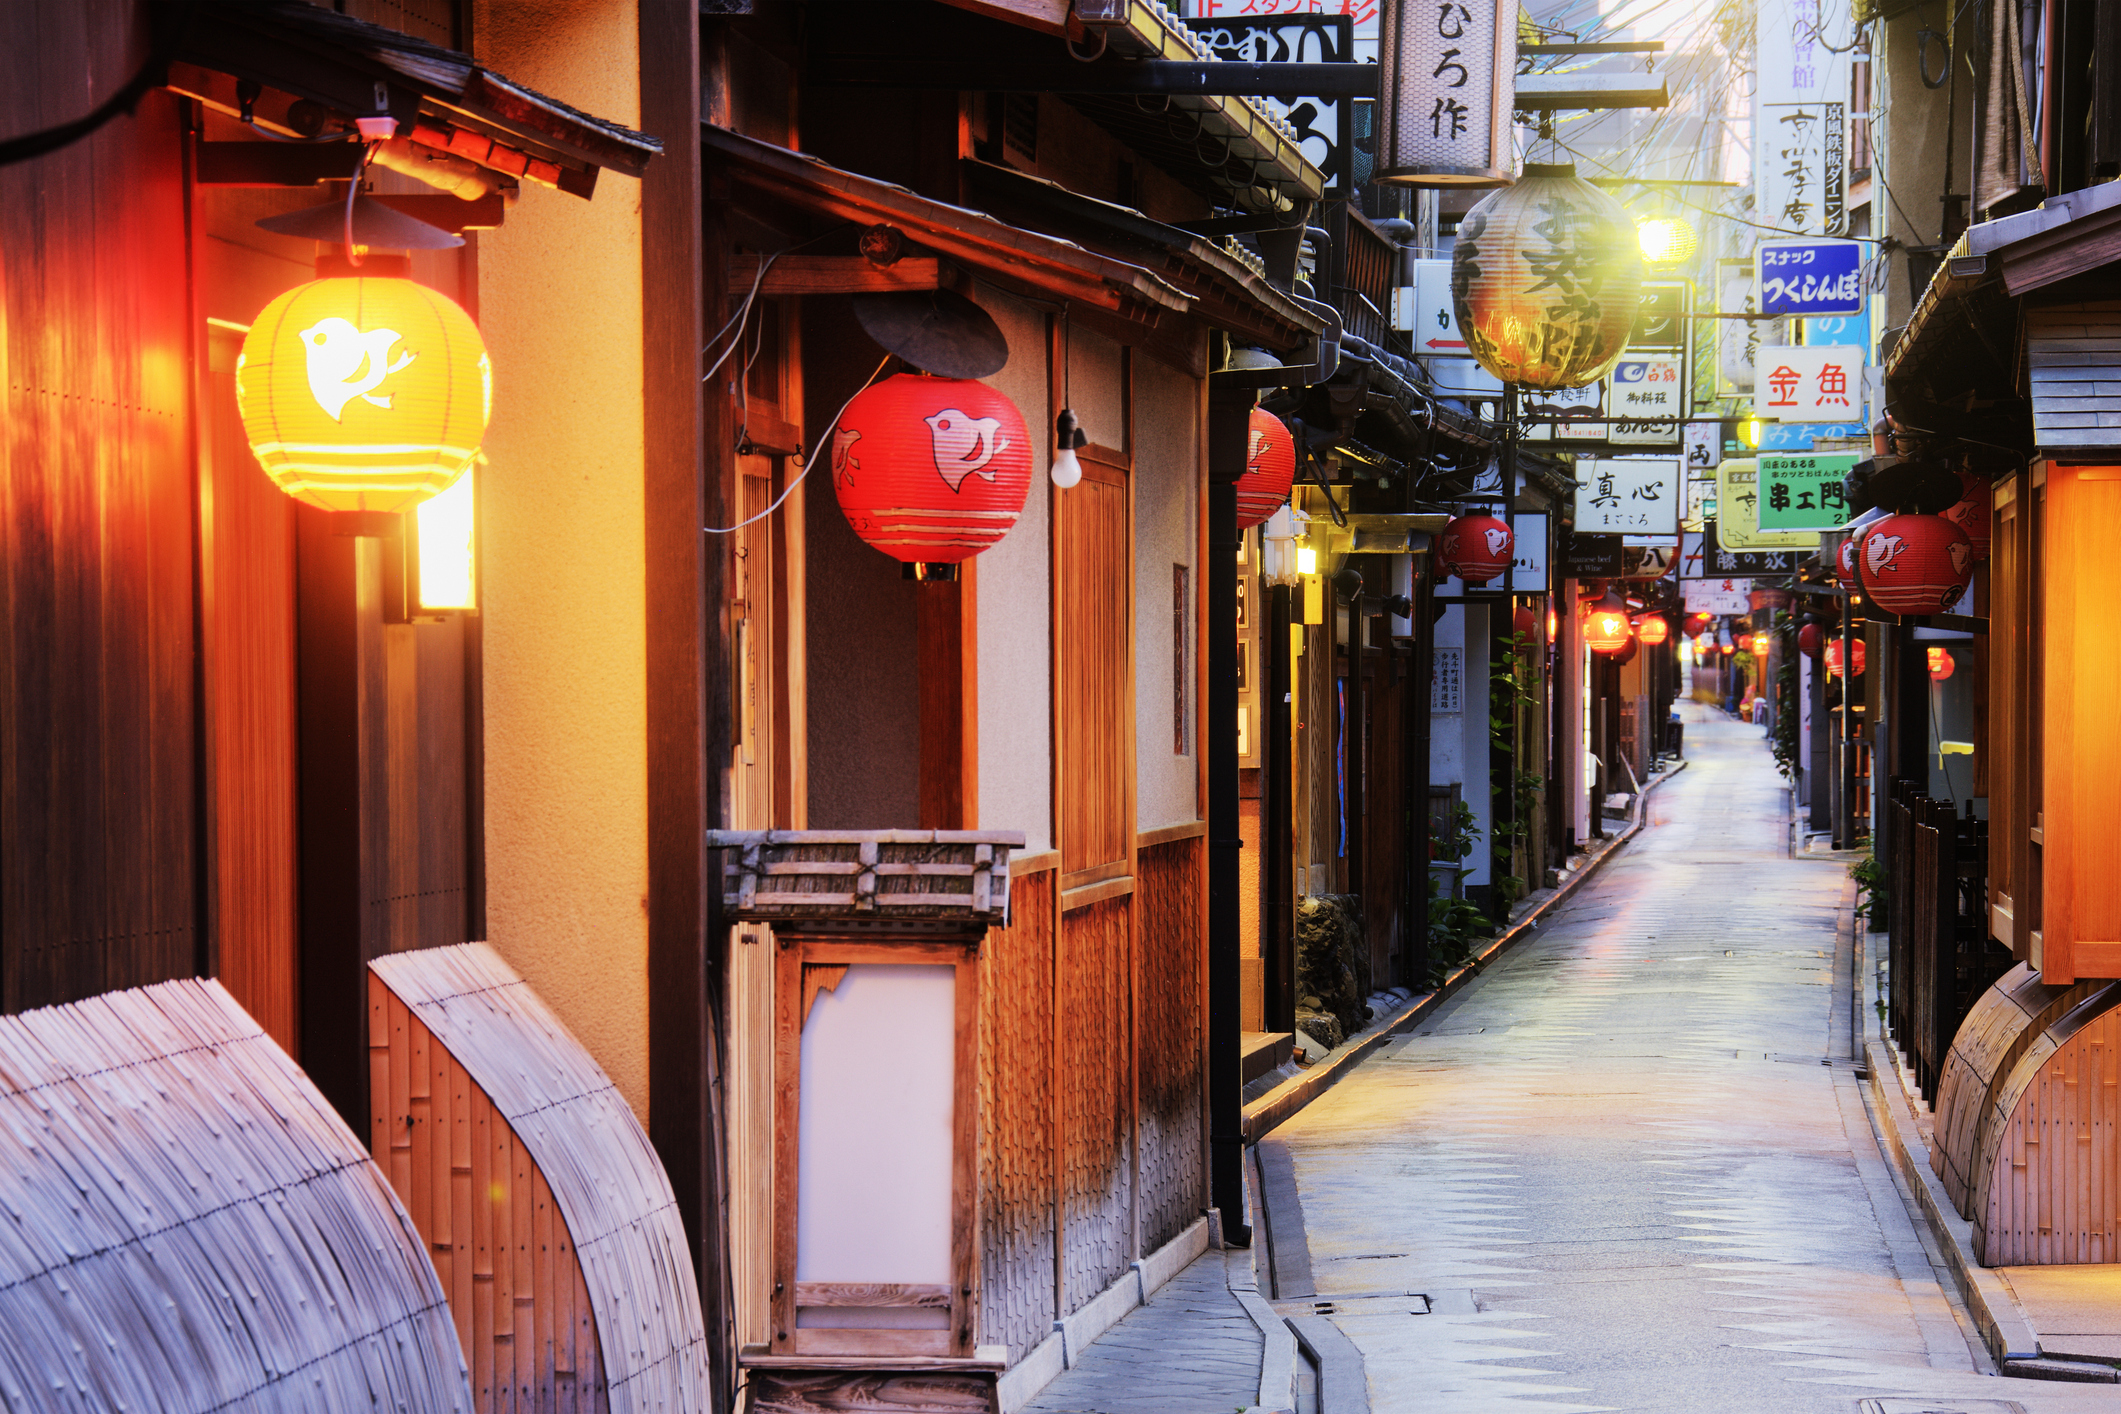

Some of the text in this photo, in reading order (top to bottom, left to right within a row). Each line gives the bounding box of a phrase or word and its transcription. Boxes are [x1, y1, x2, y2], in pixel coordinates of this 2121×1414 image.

[1429, 2, 1472, 141] ひろ作
[1764, 249, 1816, 266] スナック
[1762, 269, 1861, 304] つくしんぼ
[1767, 363, 1850, 407] 金魚
[1589, 472, 1664, 508] 真心
[1602, 513, 1649, 527] まごころ
